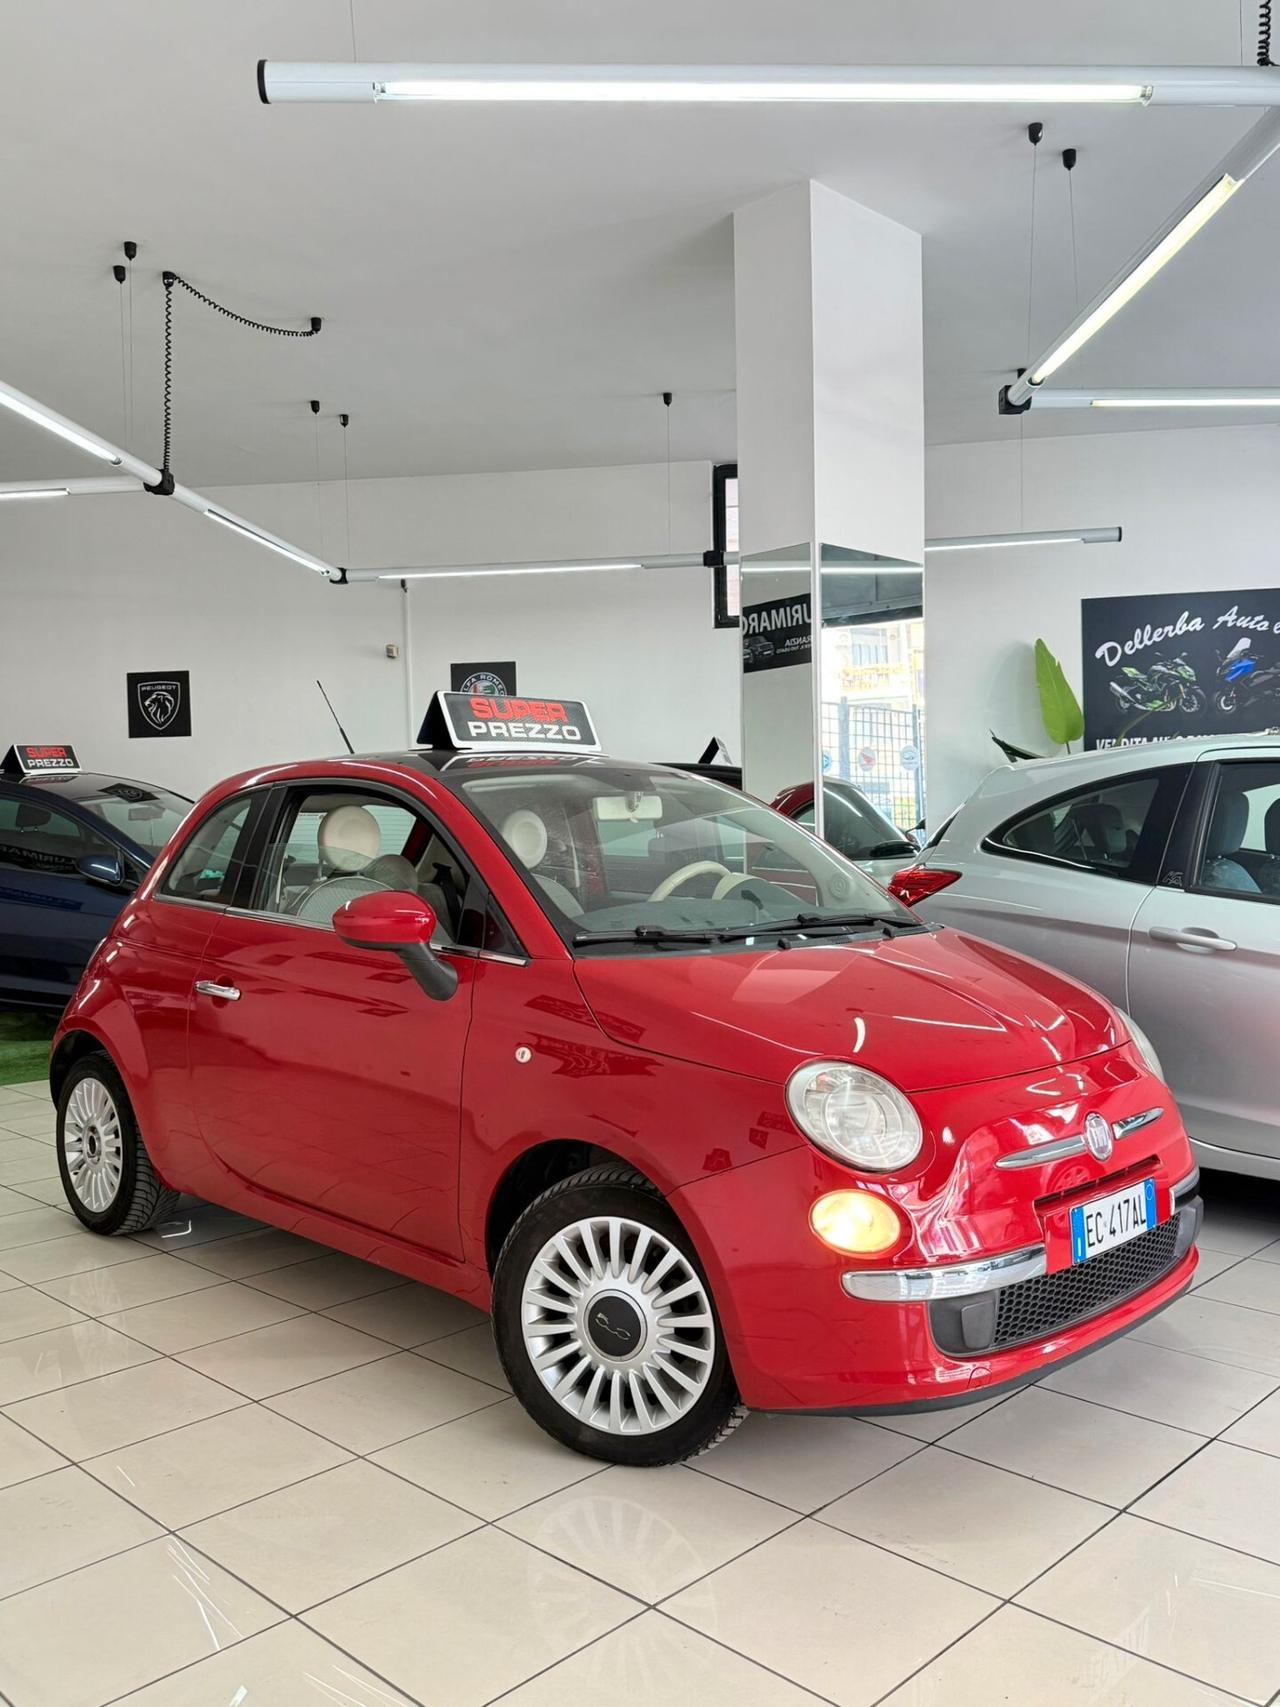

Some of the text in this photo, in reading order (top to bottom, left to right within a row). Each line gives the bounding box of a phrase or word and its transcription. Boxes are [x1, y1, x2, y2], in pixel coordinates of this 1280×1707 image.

[1095, 611, 1206, 667] Dellerba
[1212, 605, 1269, 631] Auto
[470, 697, 569, 724] SUPER
[467, 721, 582, 741] PREZZO
[26, 747, 67, 758] SUPER
[27, 758, 74, 768] PREZZO
[1086, 1194, 1146, 1248] EC 417AL
